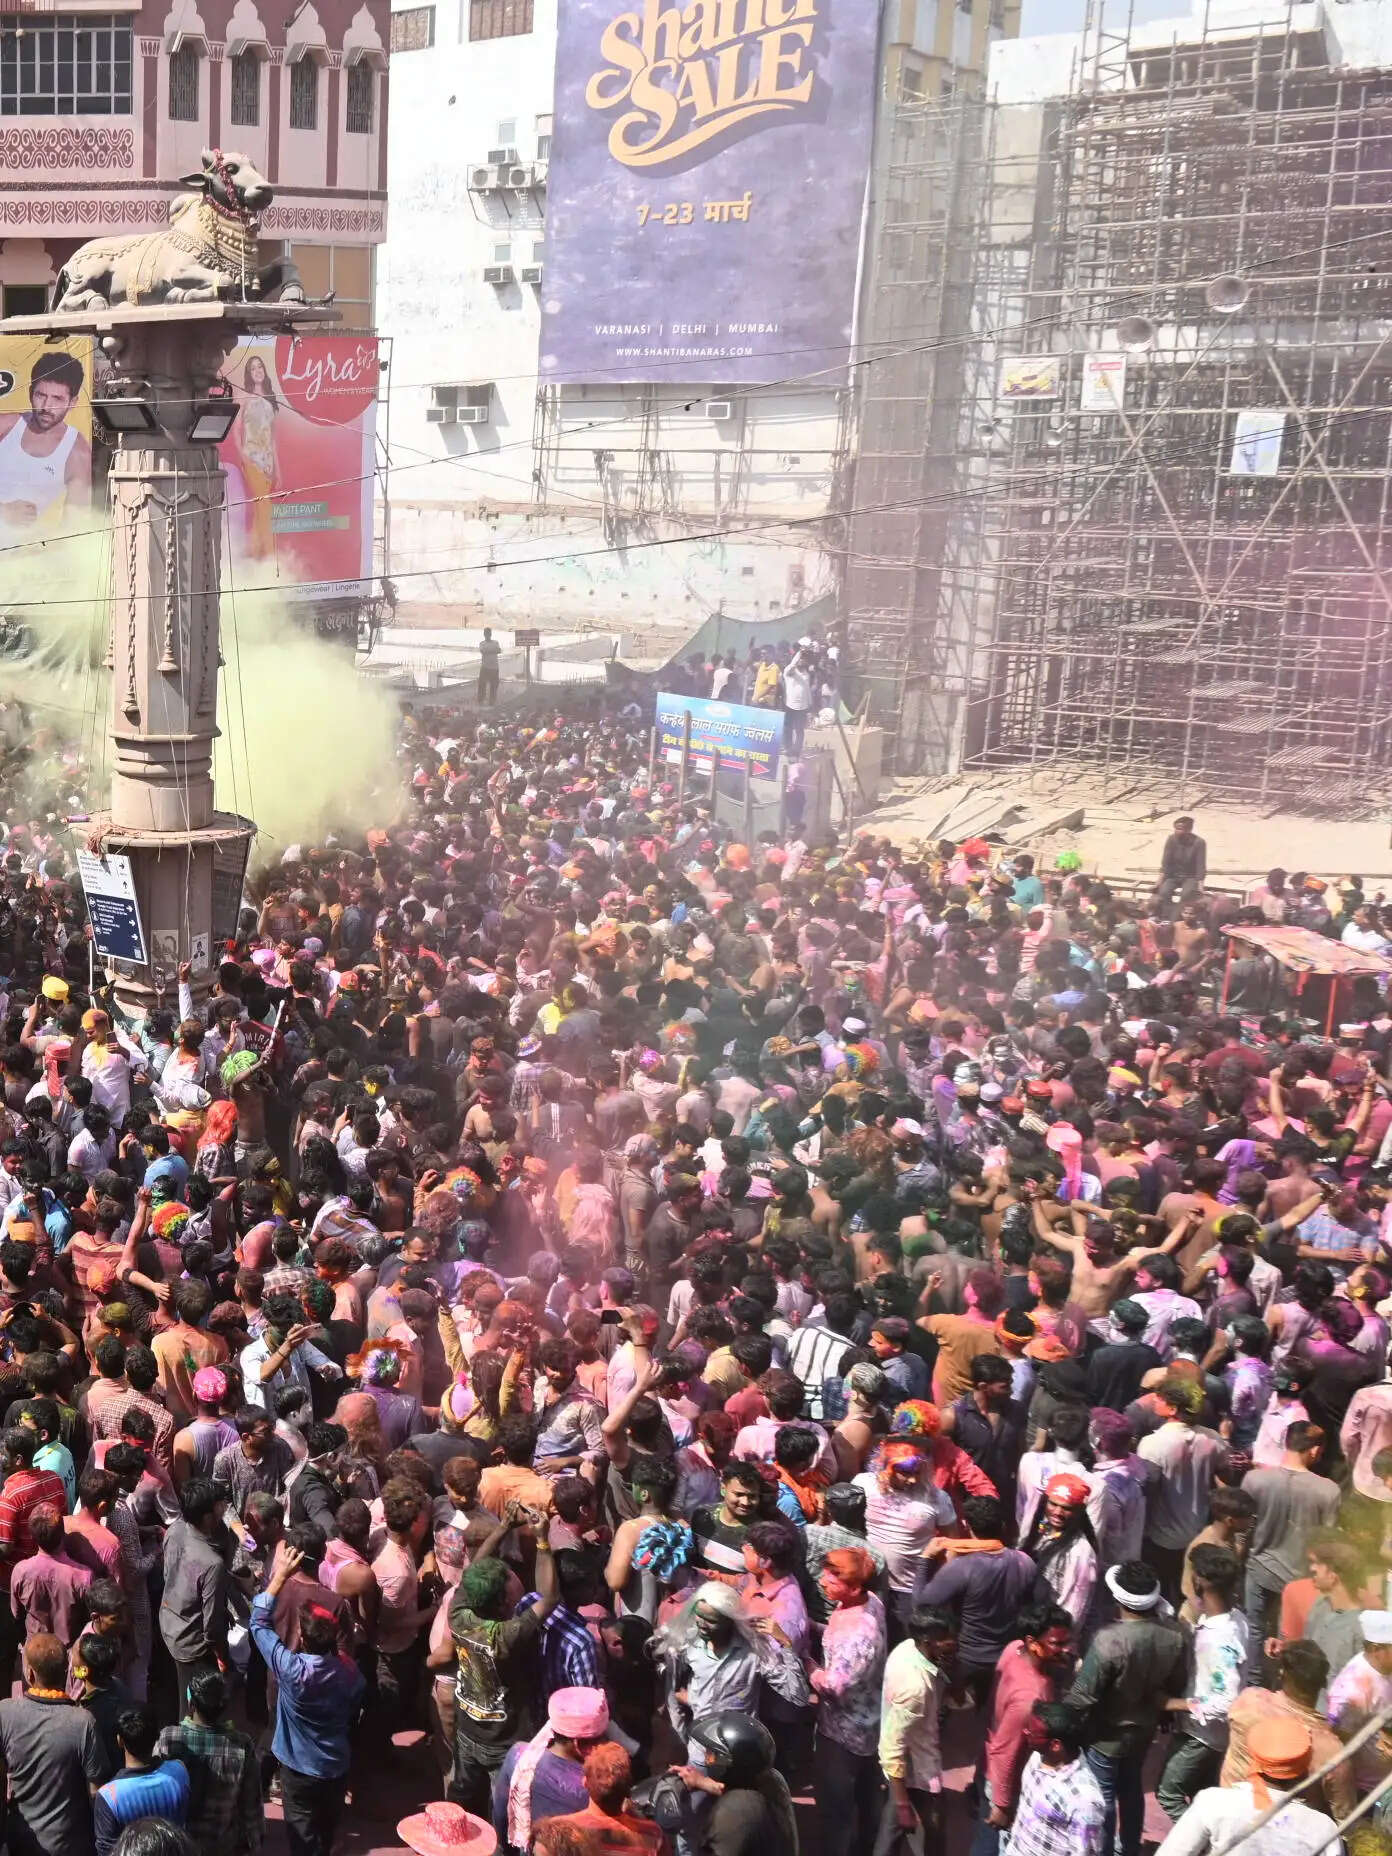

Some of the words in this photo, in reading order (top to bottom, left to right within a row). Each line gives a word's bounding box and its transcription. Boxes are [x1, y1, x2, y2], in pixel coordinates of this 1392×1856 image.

[608, 23, 814, 166] SALE
[704, 191, 753, 223] मार्च
[594, 324, 650, 335] VARANASI
[672, 324, 706, 334] DELHI
[728, 323, 778, 334] MUMBAI
[616, 347, 753, 357] WWW.SHANTIBANARAS.COM
[281, 340, 363, 402] Lyra
